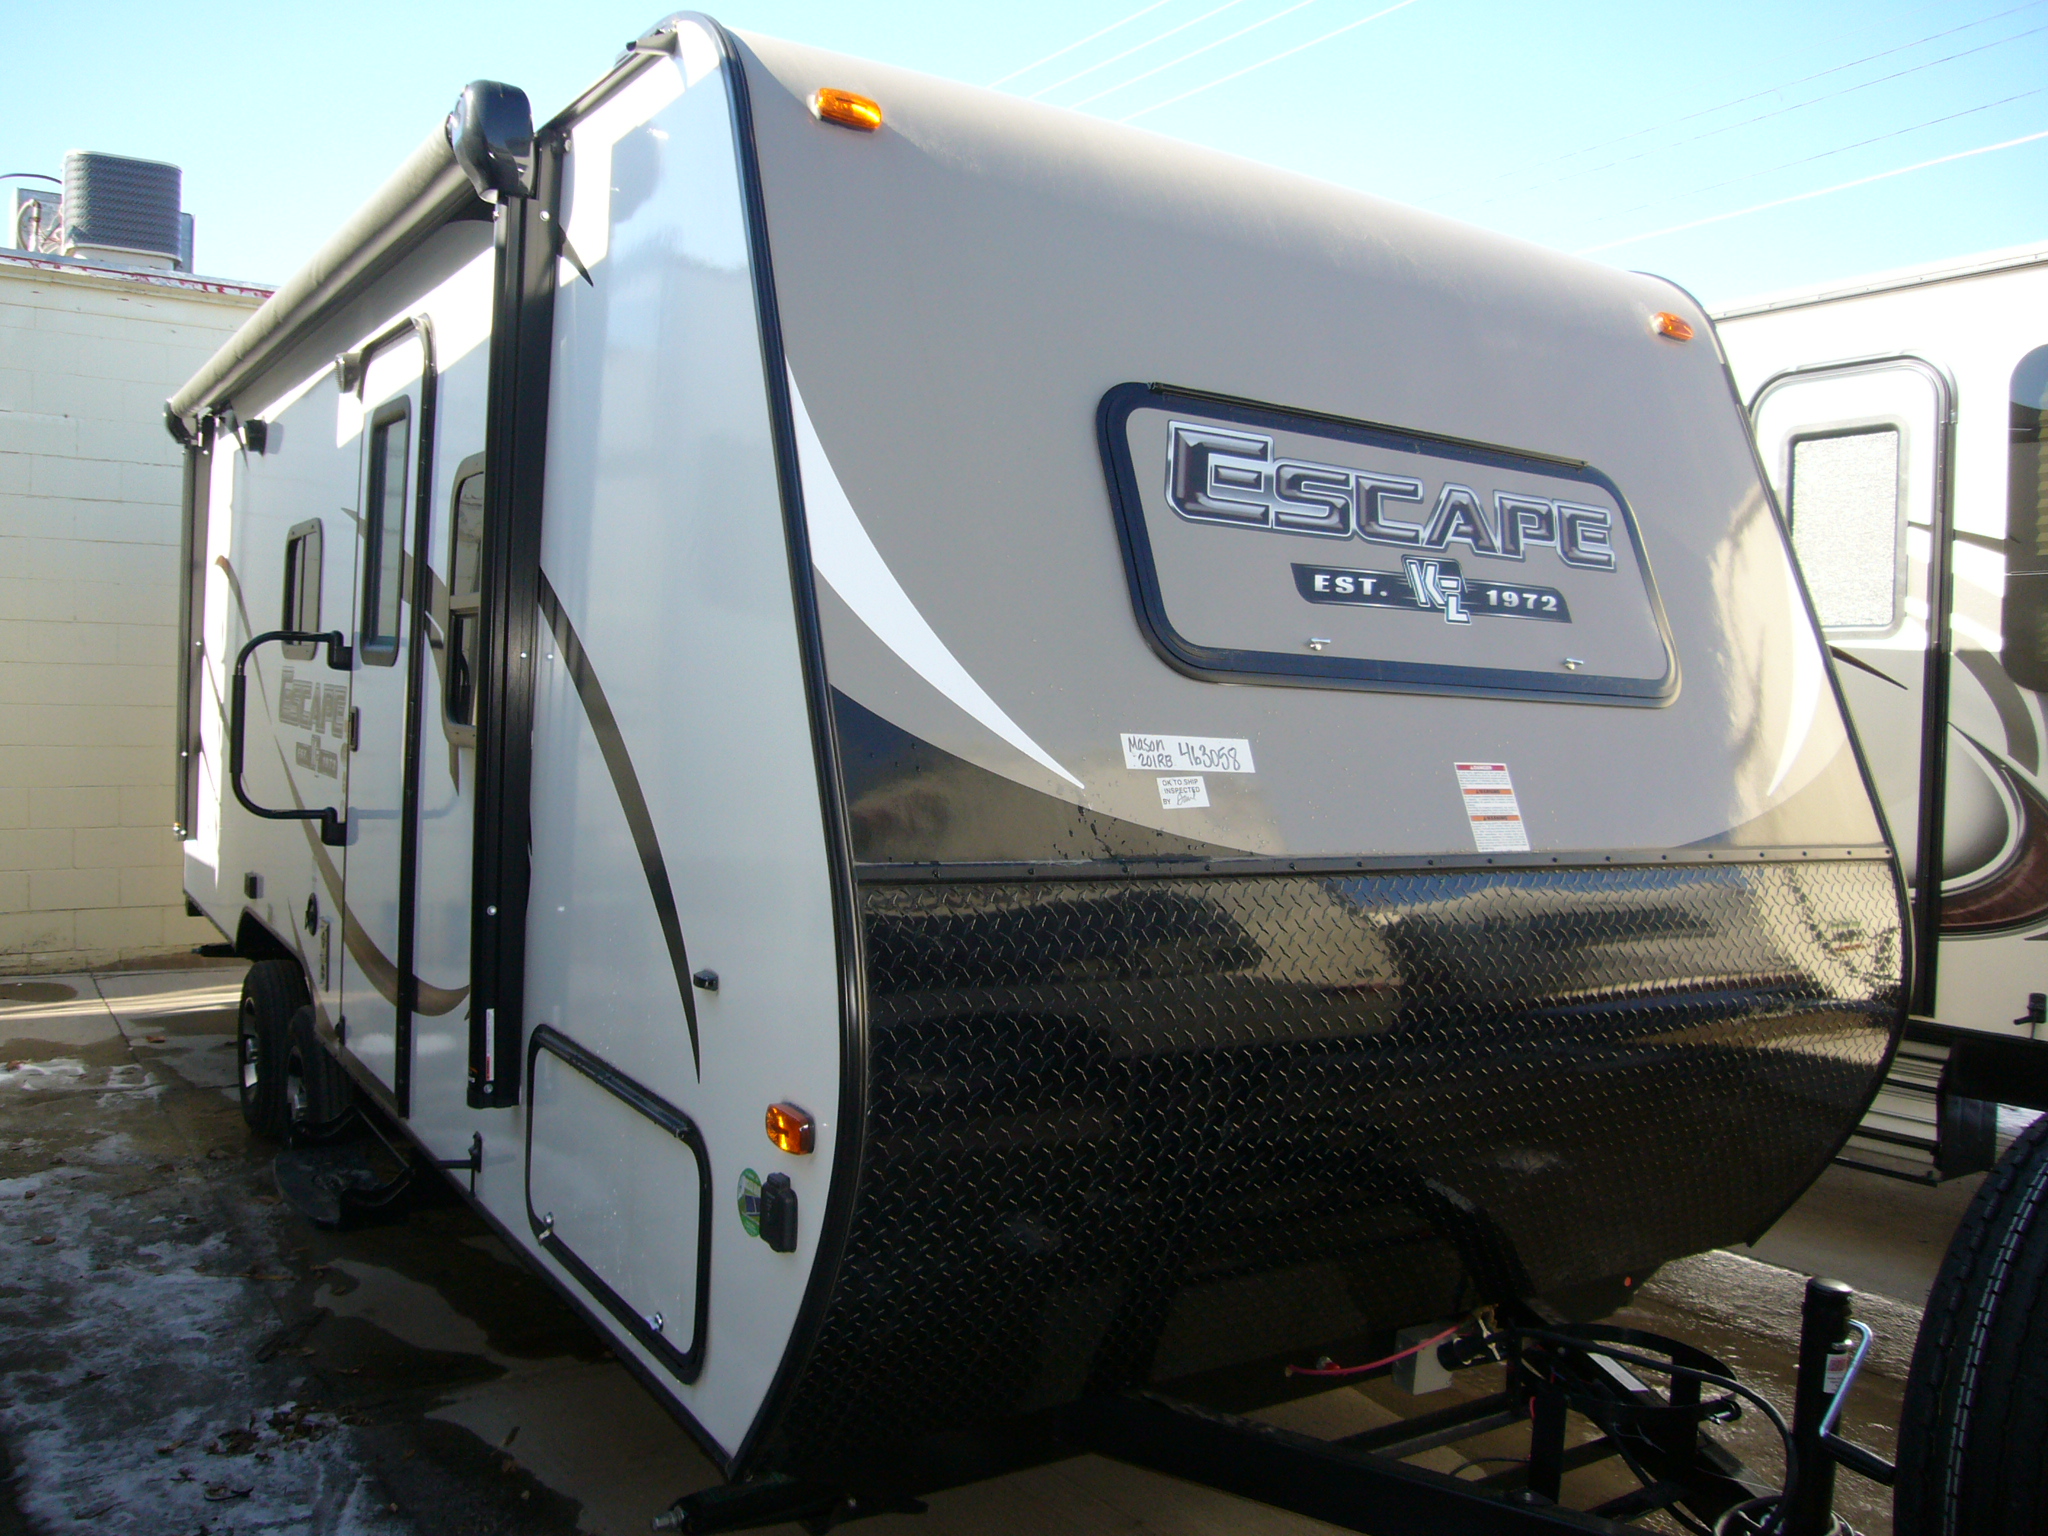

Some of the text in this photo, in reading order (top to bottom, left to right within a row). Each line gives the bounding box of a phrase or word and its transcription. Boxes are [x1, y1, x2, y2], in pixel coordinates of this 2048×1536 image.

[1164, 420, 1617, 572] ESCAPE
[1314, 574, 1388, 597] EST.
[1486, 589, 1558, 612] 1972
[1138, 753, 1173, 768] 201RB
[1178, 742, 1241, 771] 463058
[1163, 786, 1200, 794] INSPECTED
